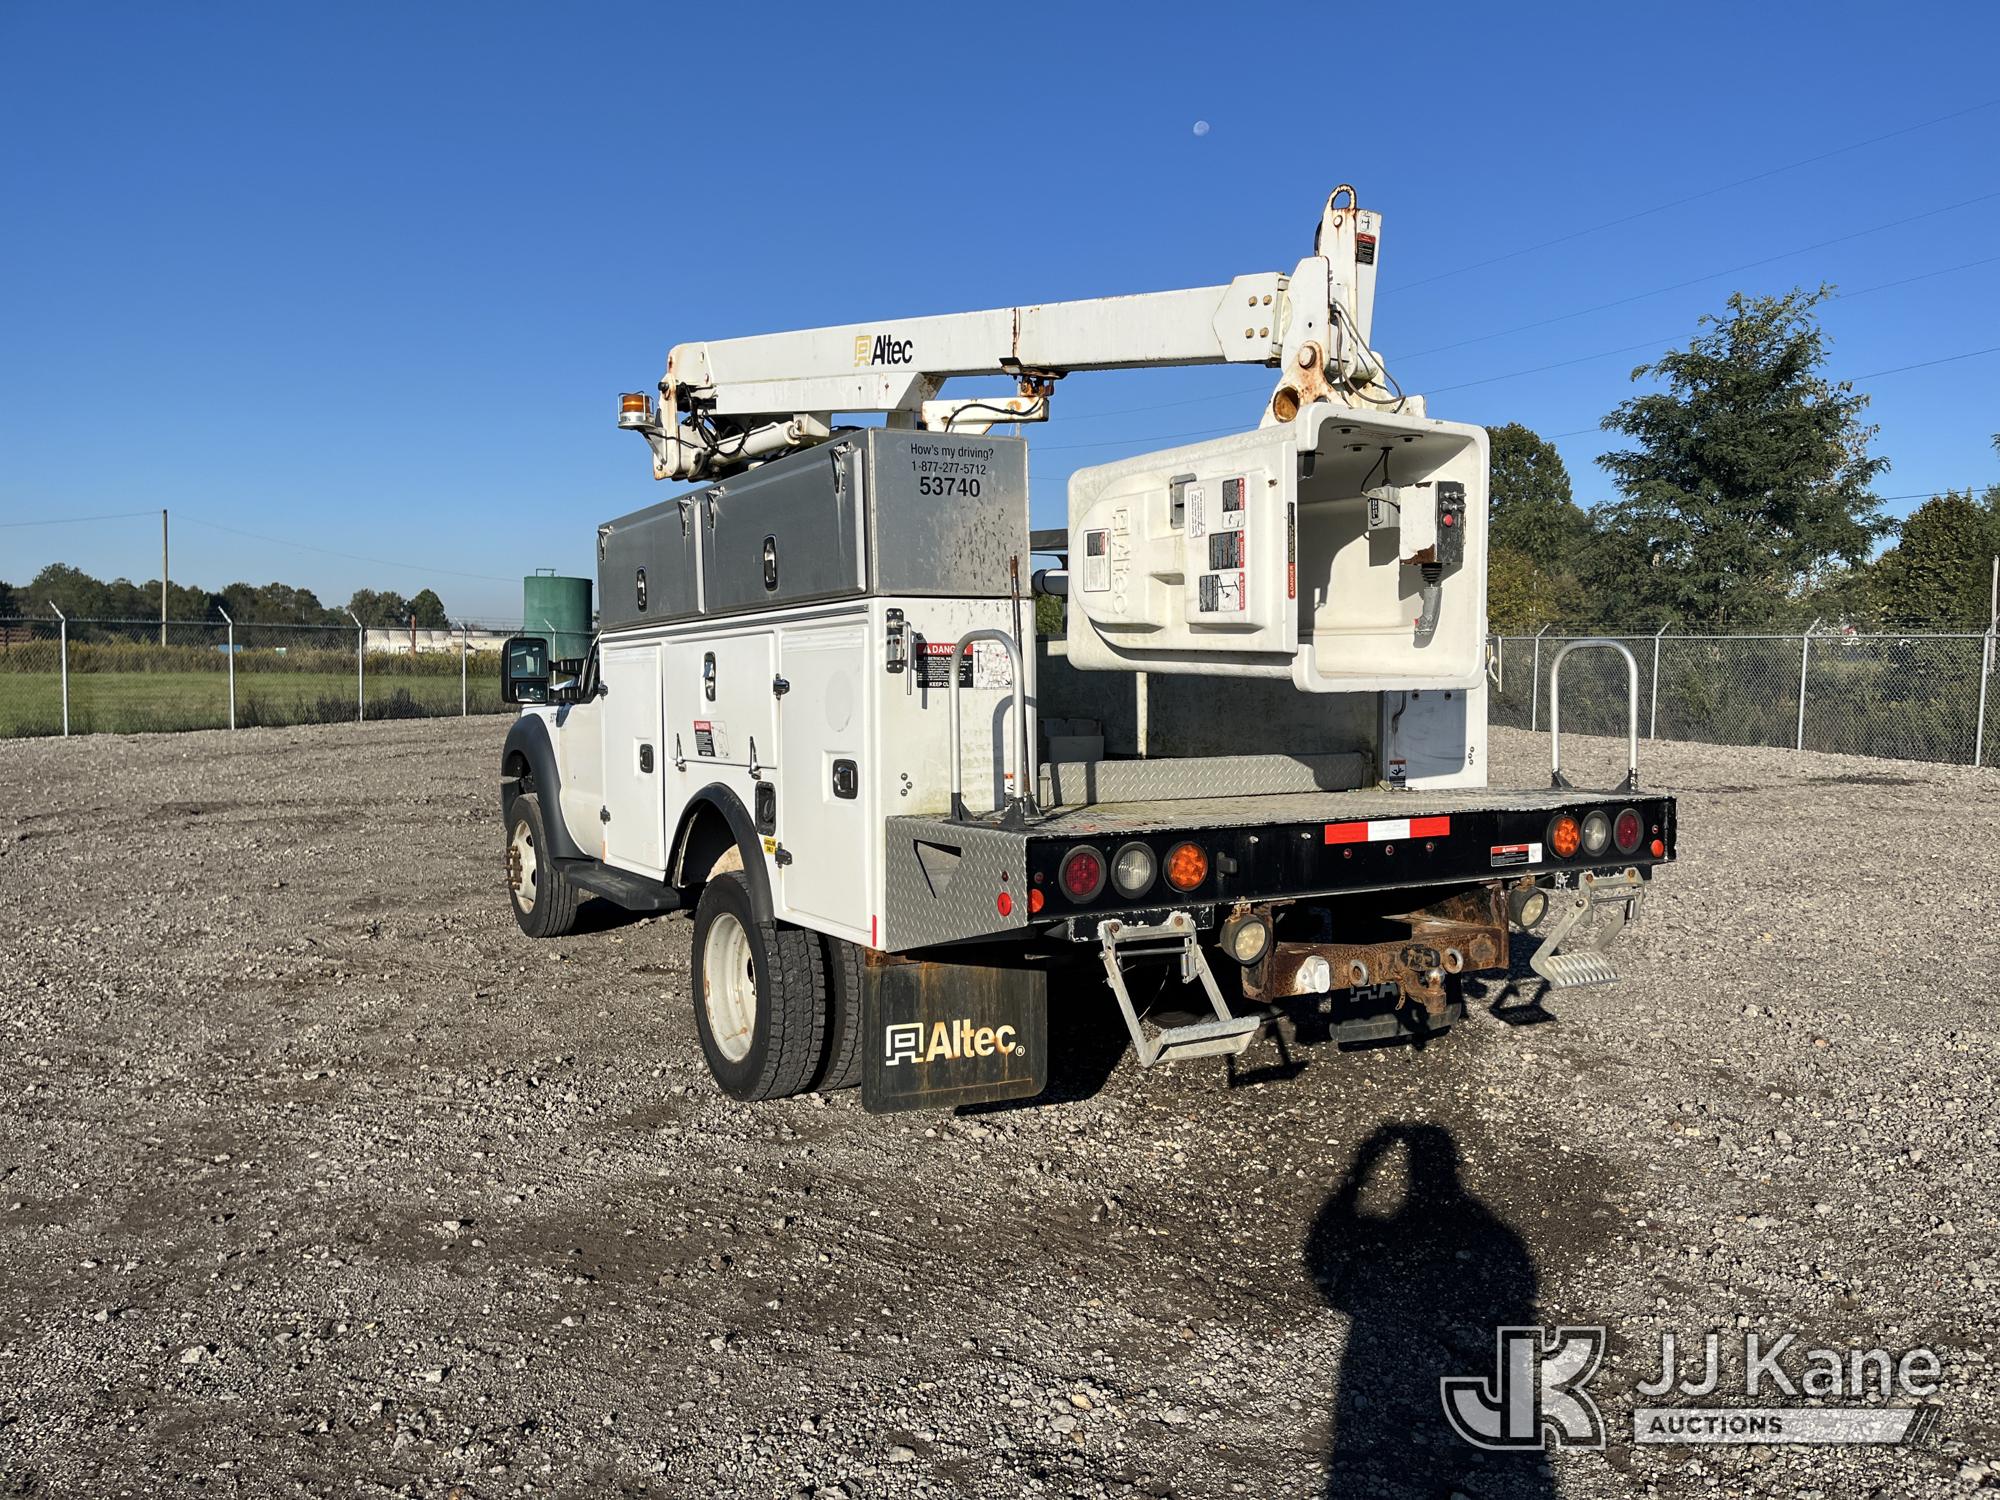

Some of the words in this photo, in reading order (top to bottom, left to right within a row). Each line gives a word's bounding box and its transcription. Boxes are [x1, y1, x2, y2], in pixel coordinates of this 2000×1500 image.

[871, 335, 913, 365] Altec
[910, 443, 939, 455] How's
[941, 447, 956, 459] my
[958, 446, 994, 461] driving?
[912, 460, 986, 475] 1-877-277-5712
[919, 476, 981, 497] 53740
